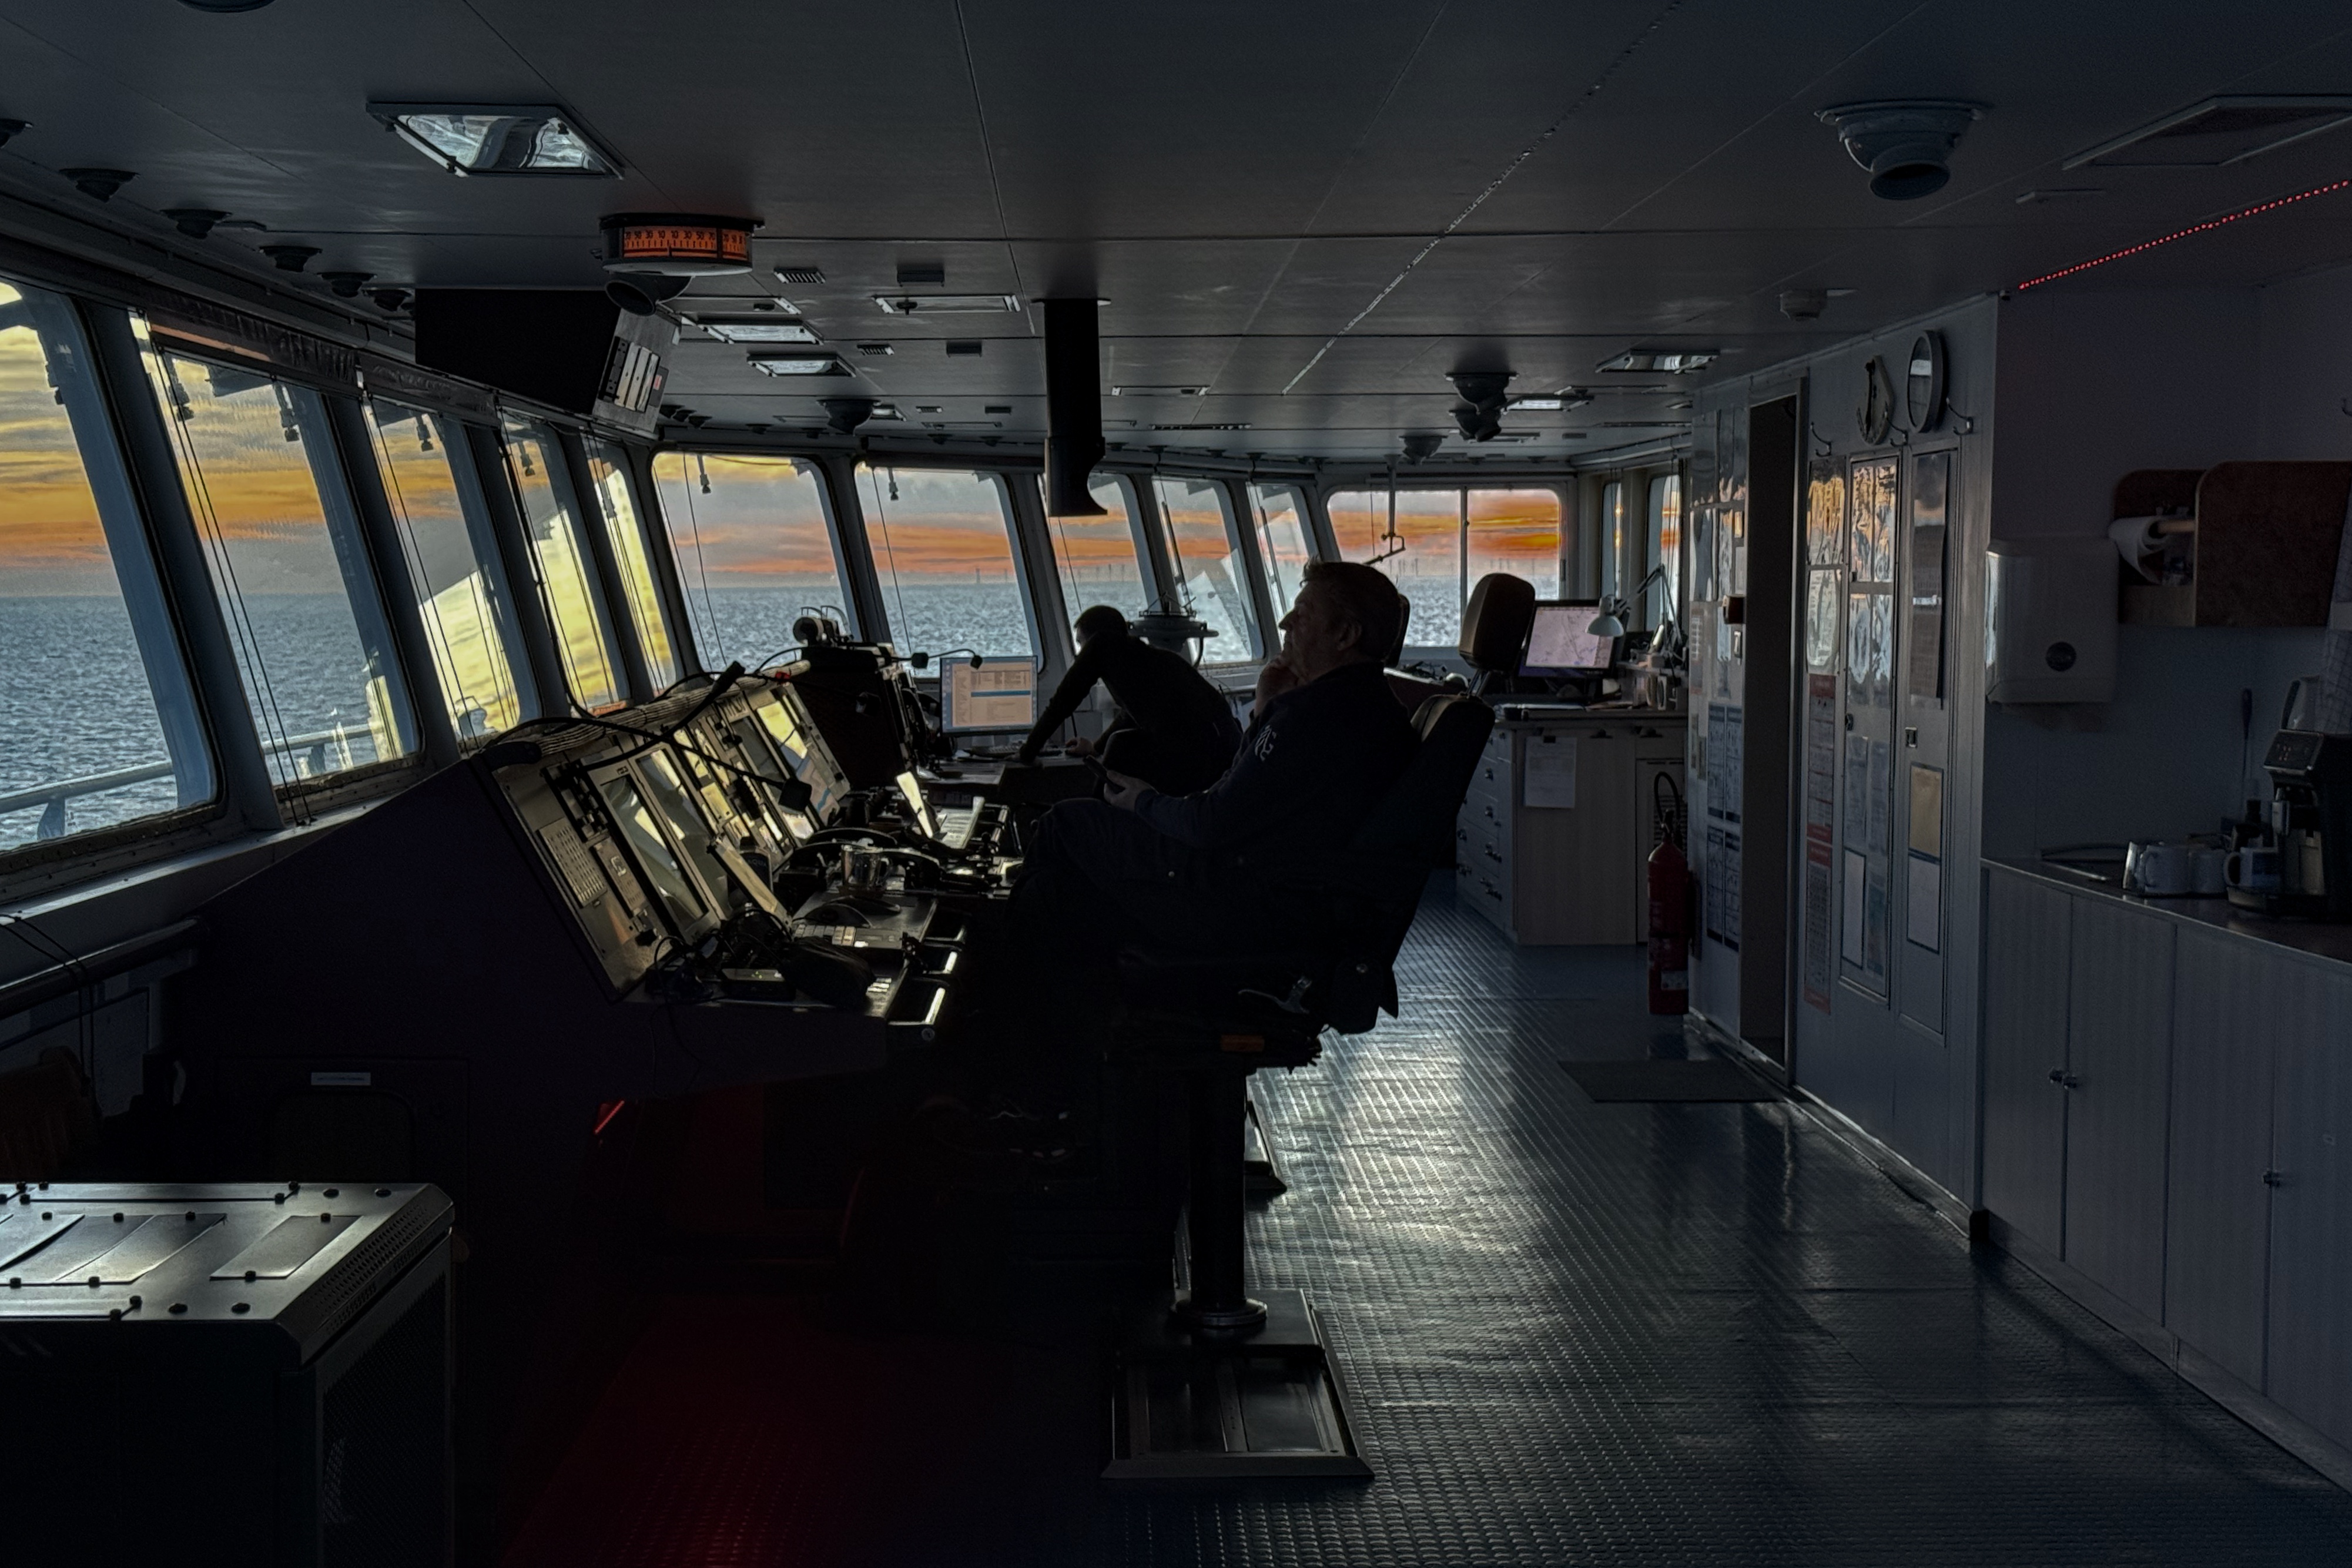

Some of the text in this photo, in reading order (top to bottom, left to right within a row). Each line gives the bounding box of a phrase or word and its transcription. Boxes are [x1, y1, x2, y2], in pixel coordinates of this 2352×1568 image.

[646, 230, 653, 239] 30
[658, 230, 665, 239] 10
[671, 230, 678, 239] 10
[684, 230, 692, 239] 30
[696, 231, 704, 240] 50
[709, 232, 715, 240] 70
